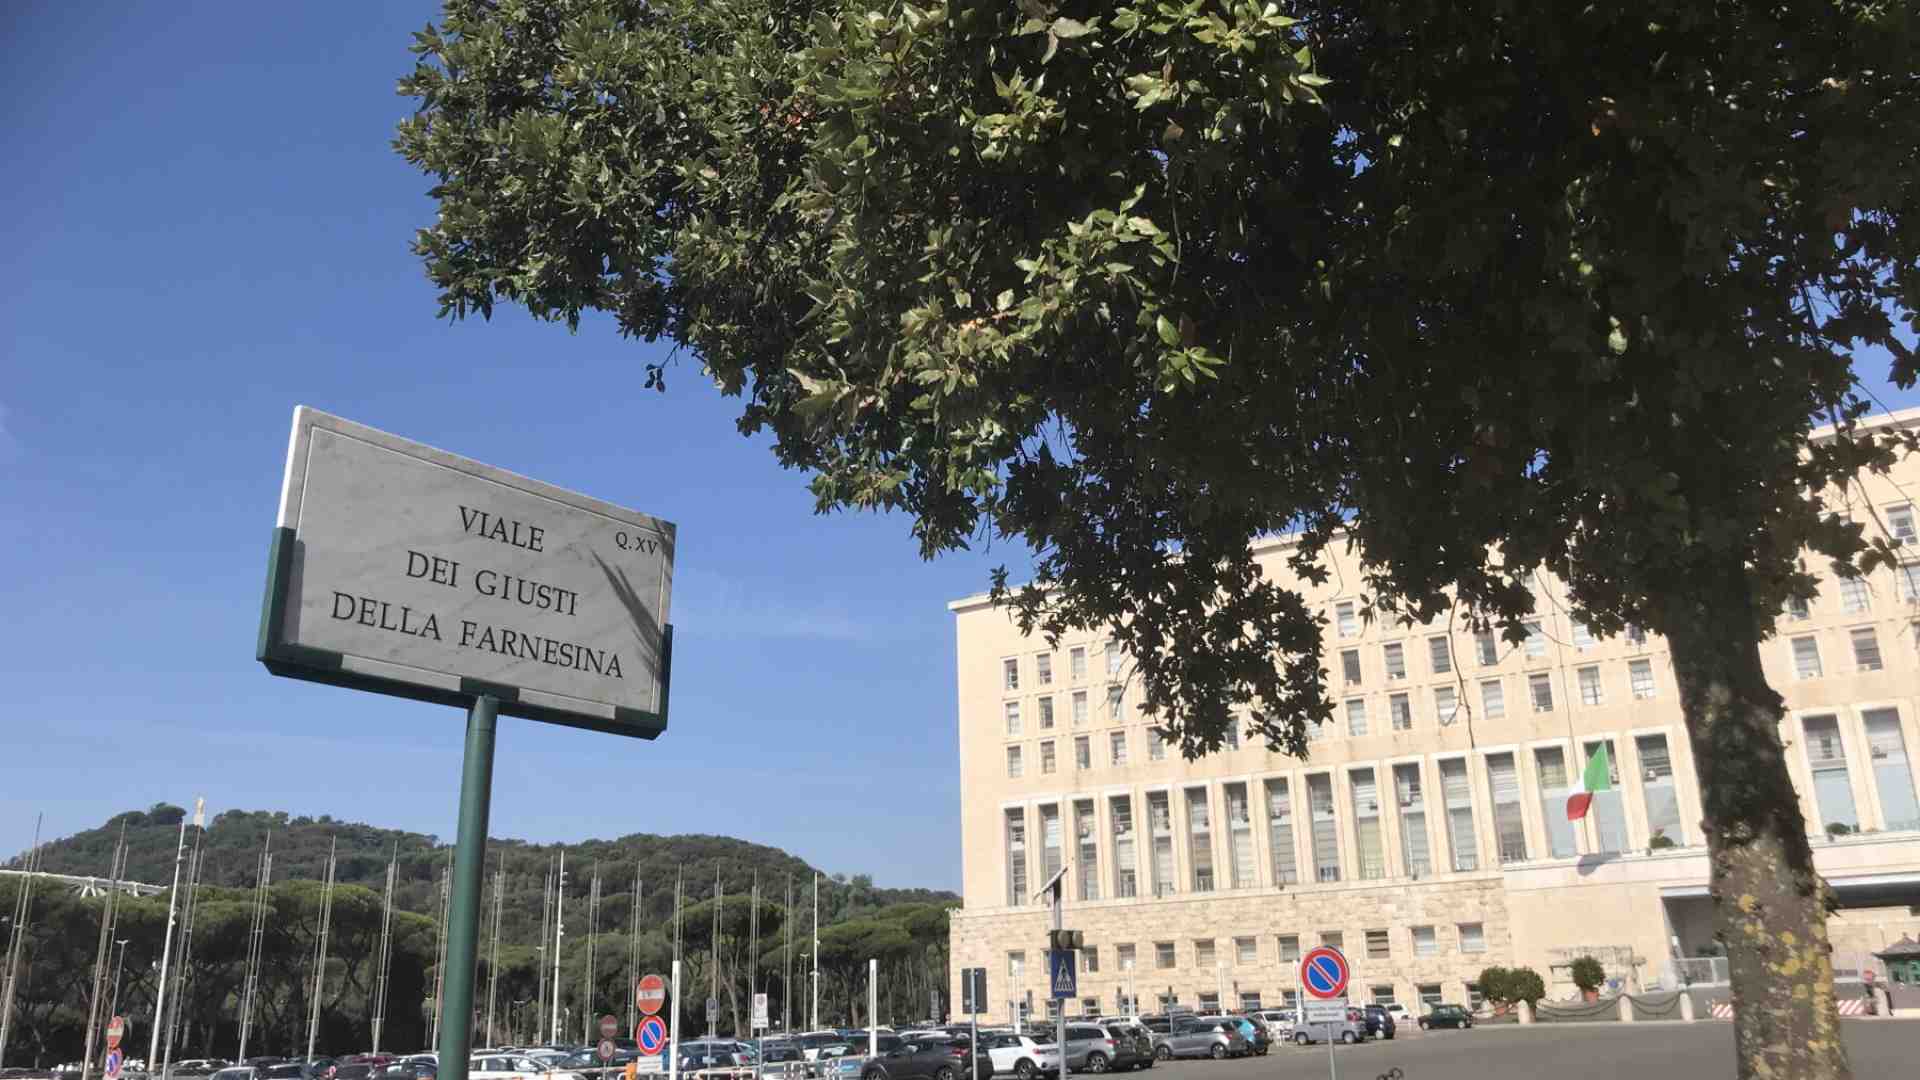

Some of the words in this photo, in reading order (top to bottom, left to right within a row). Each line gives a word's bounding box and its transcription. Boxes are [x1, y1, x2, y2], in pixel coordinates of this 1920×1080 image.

[458, 504, 545, 553] VIALE
[406, 549, 460, 588] DEI
[474, 569, 579, 616] GIUSTI
[331, 591, 442, 642] DELLA
[457, 620, 624, 679] FARNESINA
